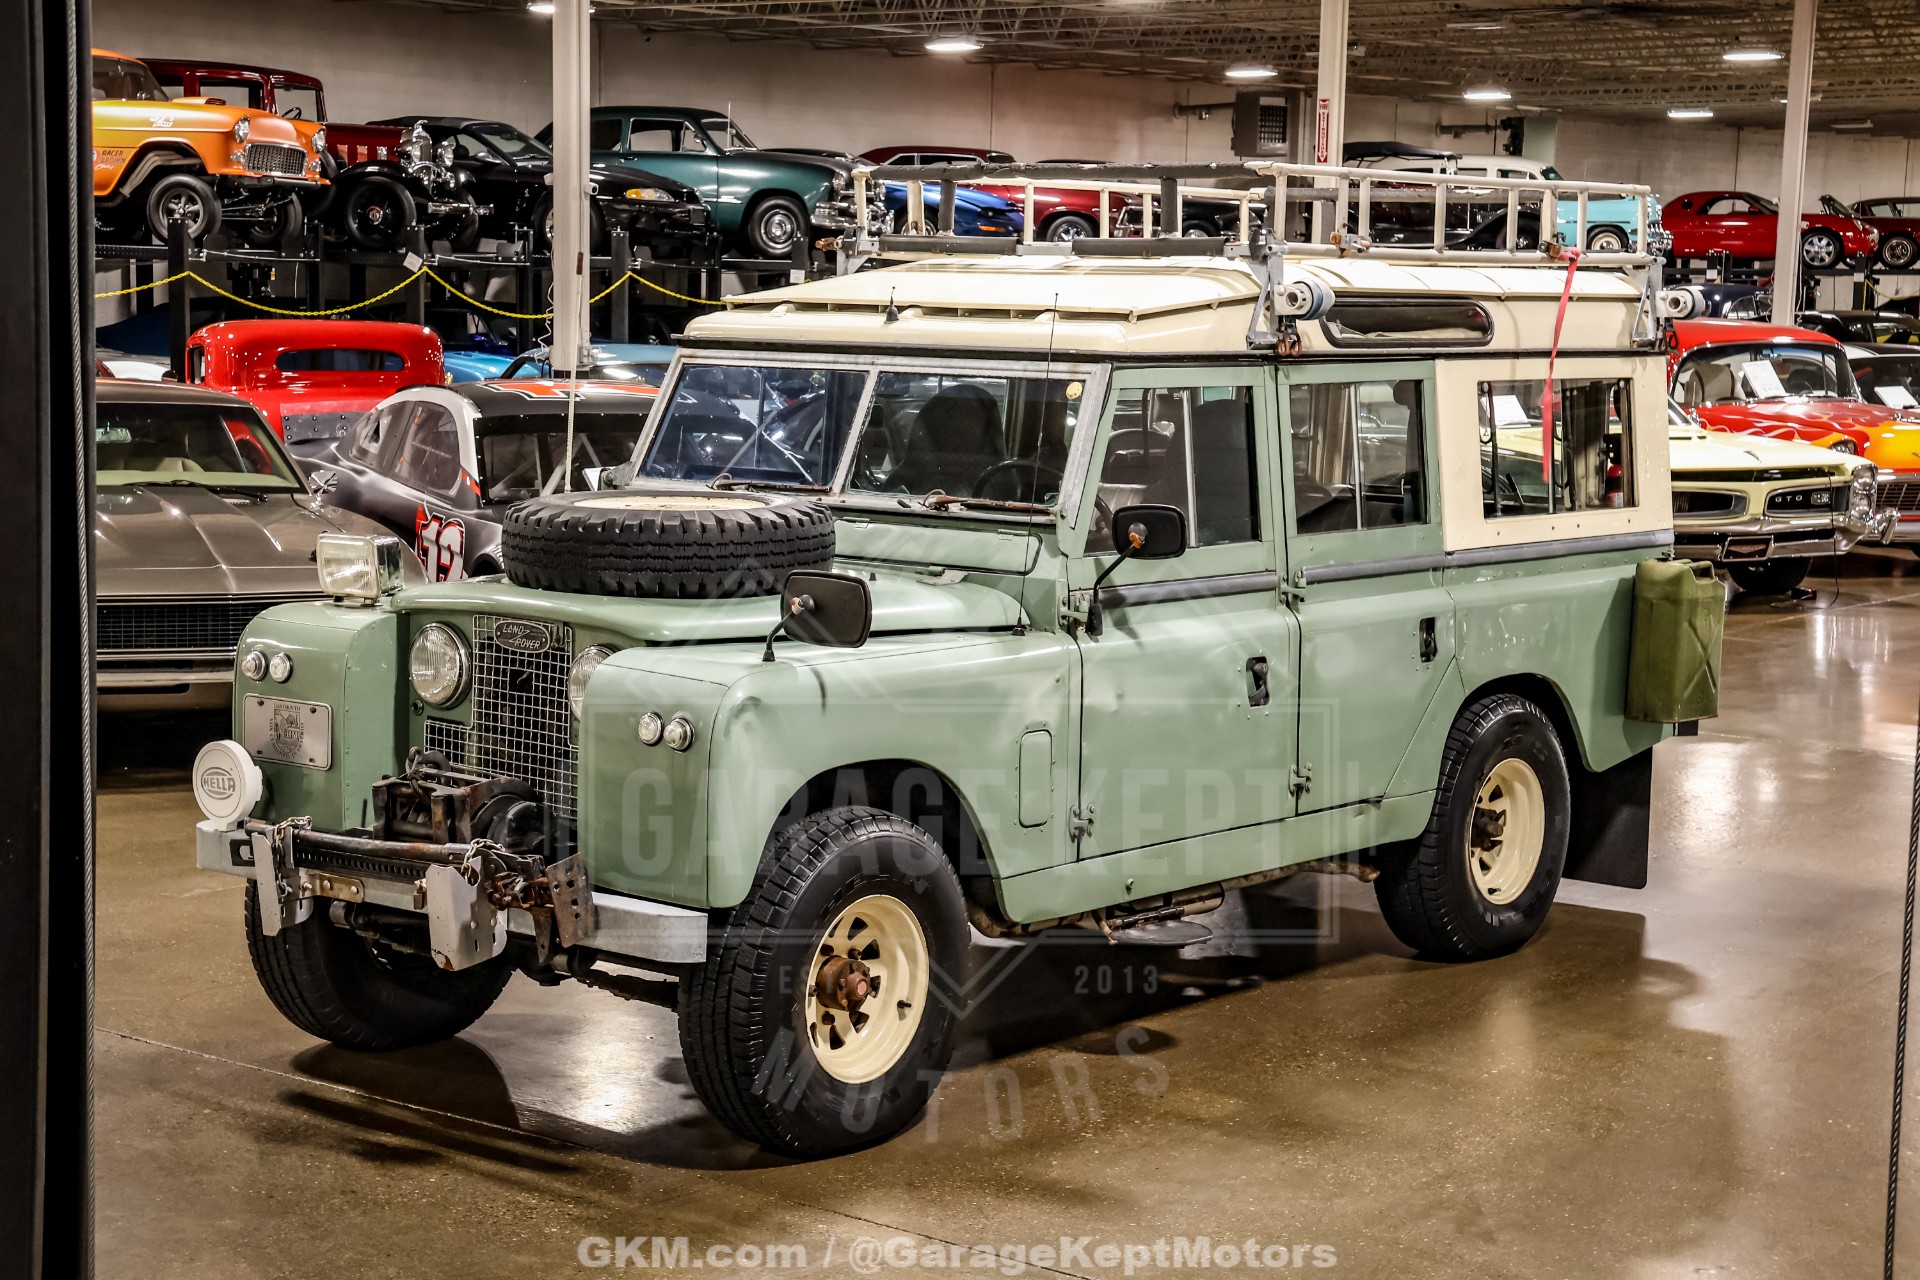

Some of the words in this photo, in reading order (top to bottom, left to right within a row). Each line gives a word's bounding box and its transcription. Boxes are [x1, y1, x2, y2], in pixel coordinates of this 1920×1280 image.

[1775, 495, 1803, 503] GTO
[502, 623, 525, 635] LAND
[514, 638, 541, 650] ROVER
[203, 777, 236, 792] HELLA
